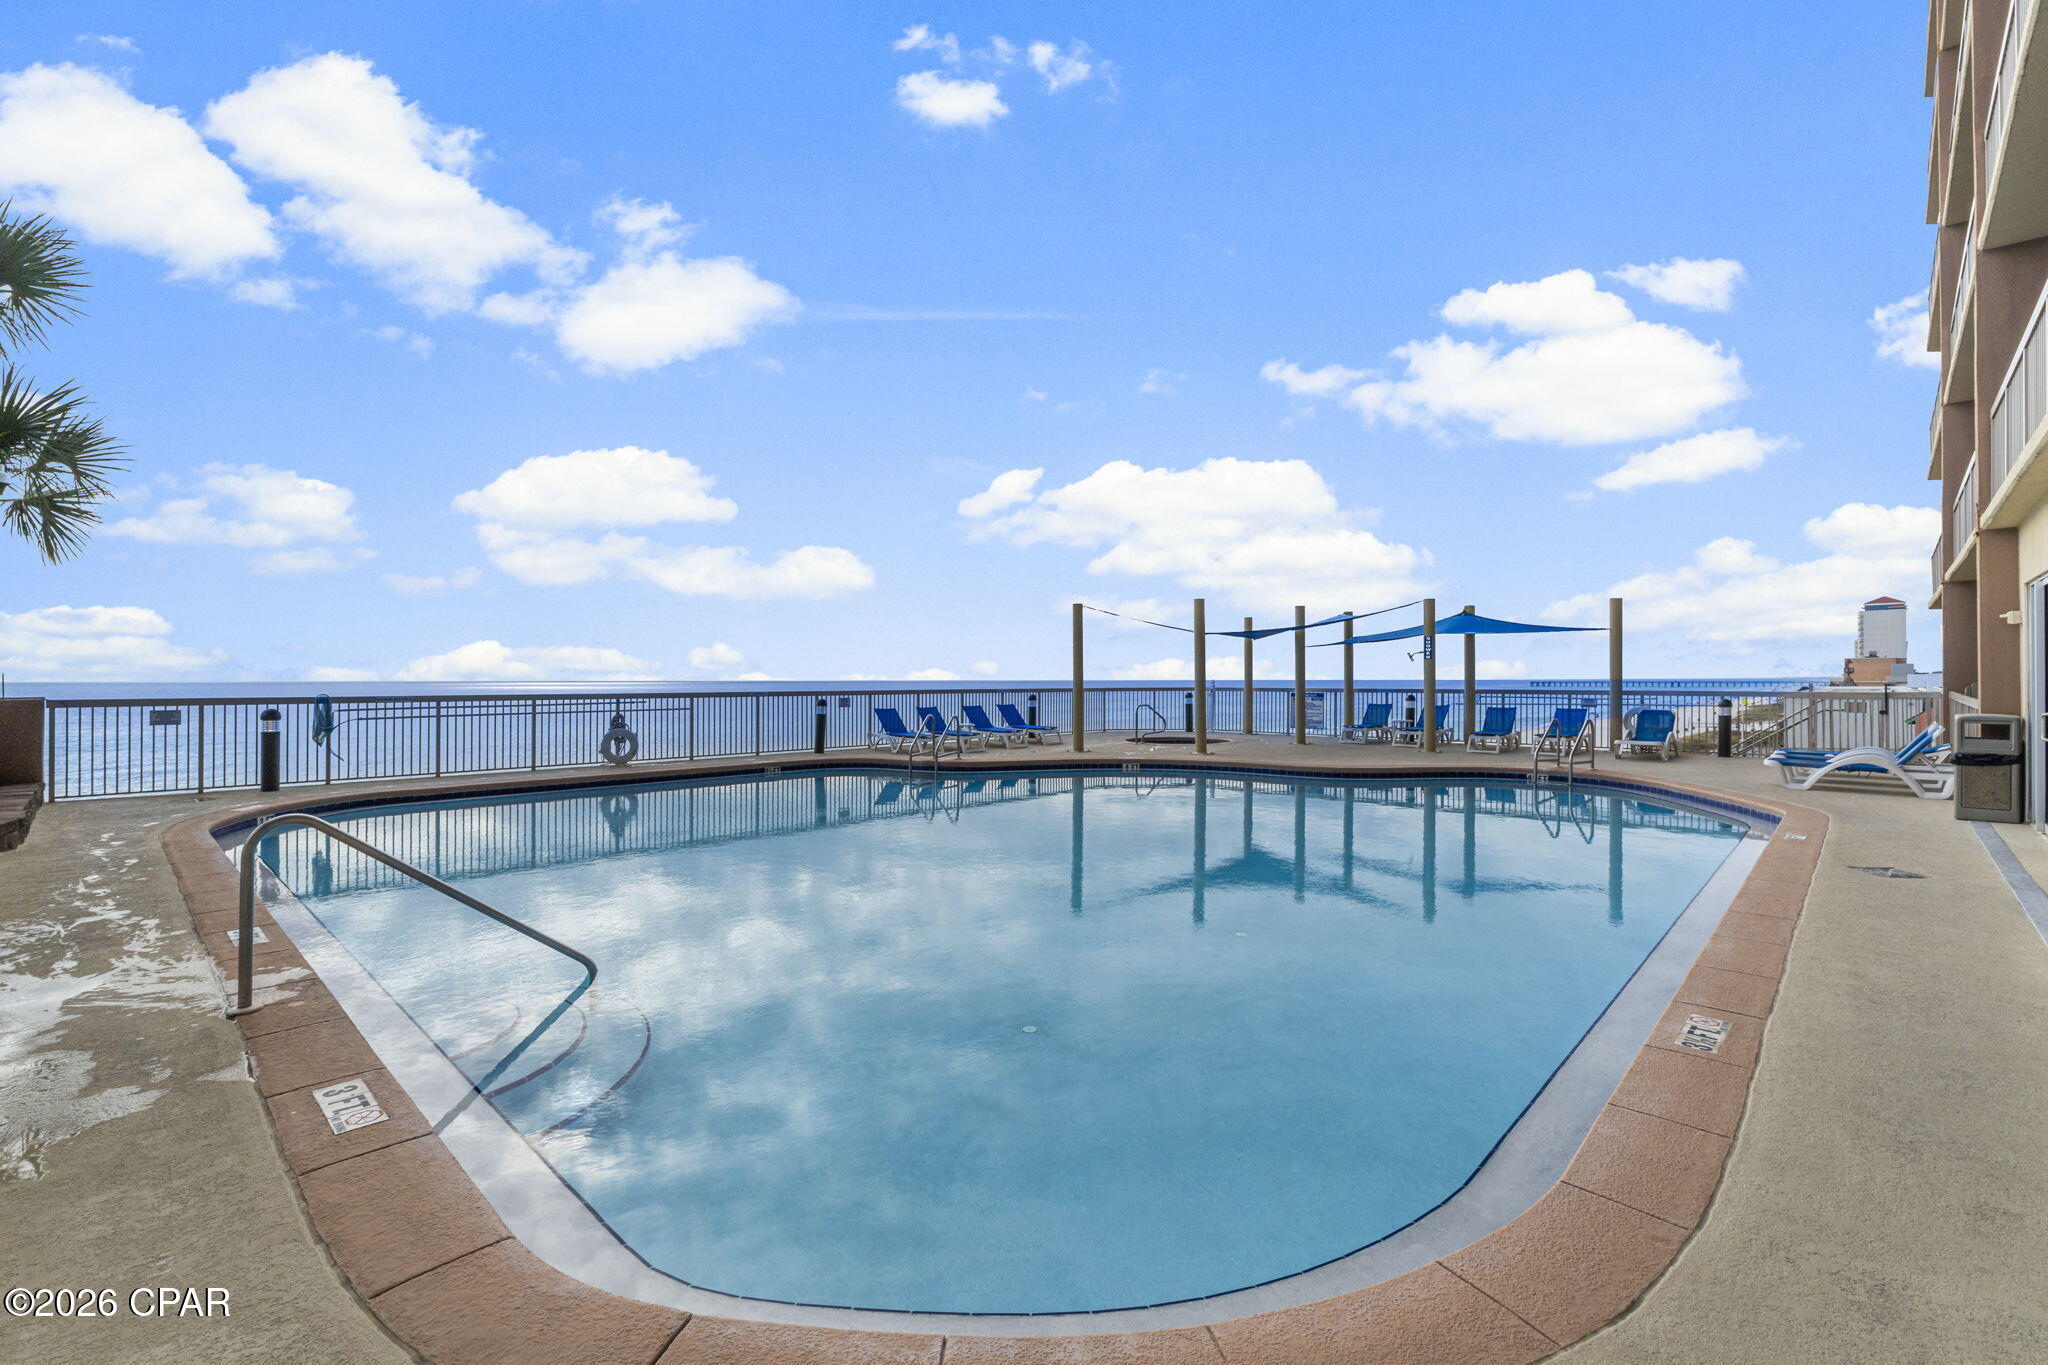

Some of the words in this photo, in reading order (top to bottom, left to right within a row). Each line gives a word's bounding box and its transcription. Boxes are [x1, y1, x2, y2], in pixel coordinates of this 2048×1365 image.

[1687, 1025, 1721, 1041] FT
[322, 1085, 358, 1098] 3
[327, 1094, 371, 1114] FT
